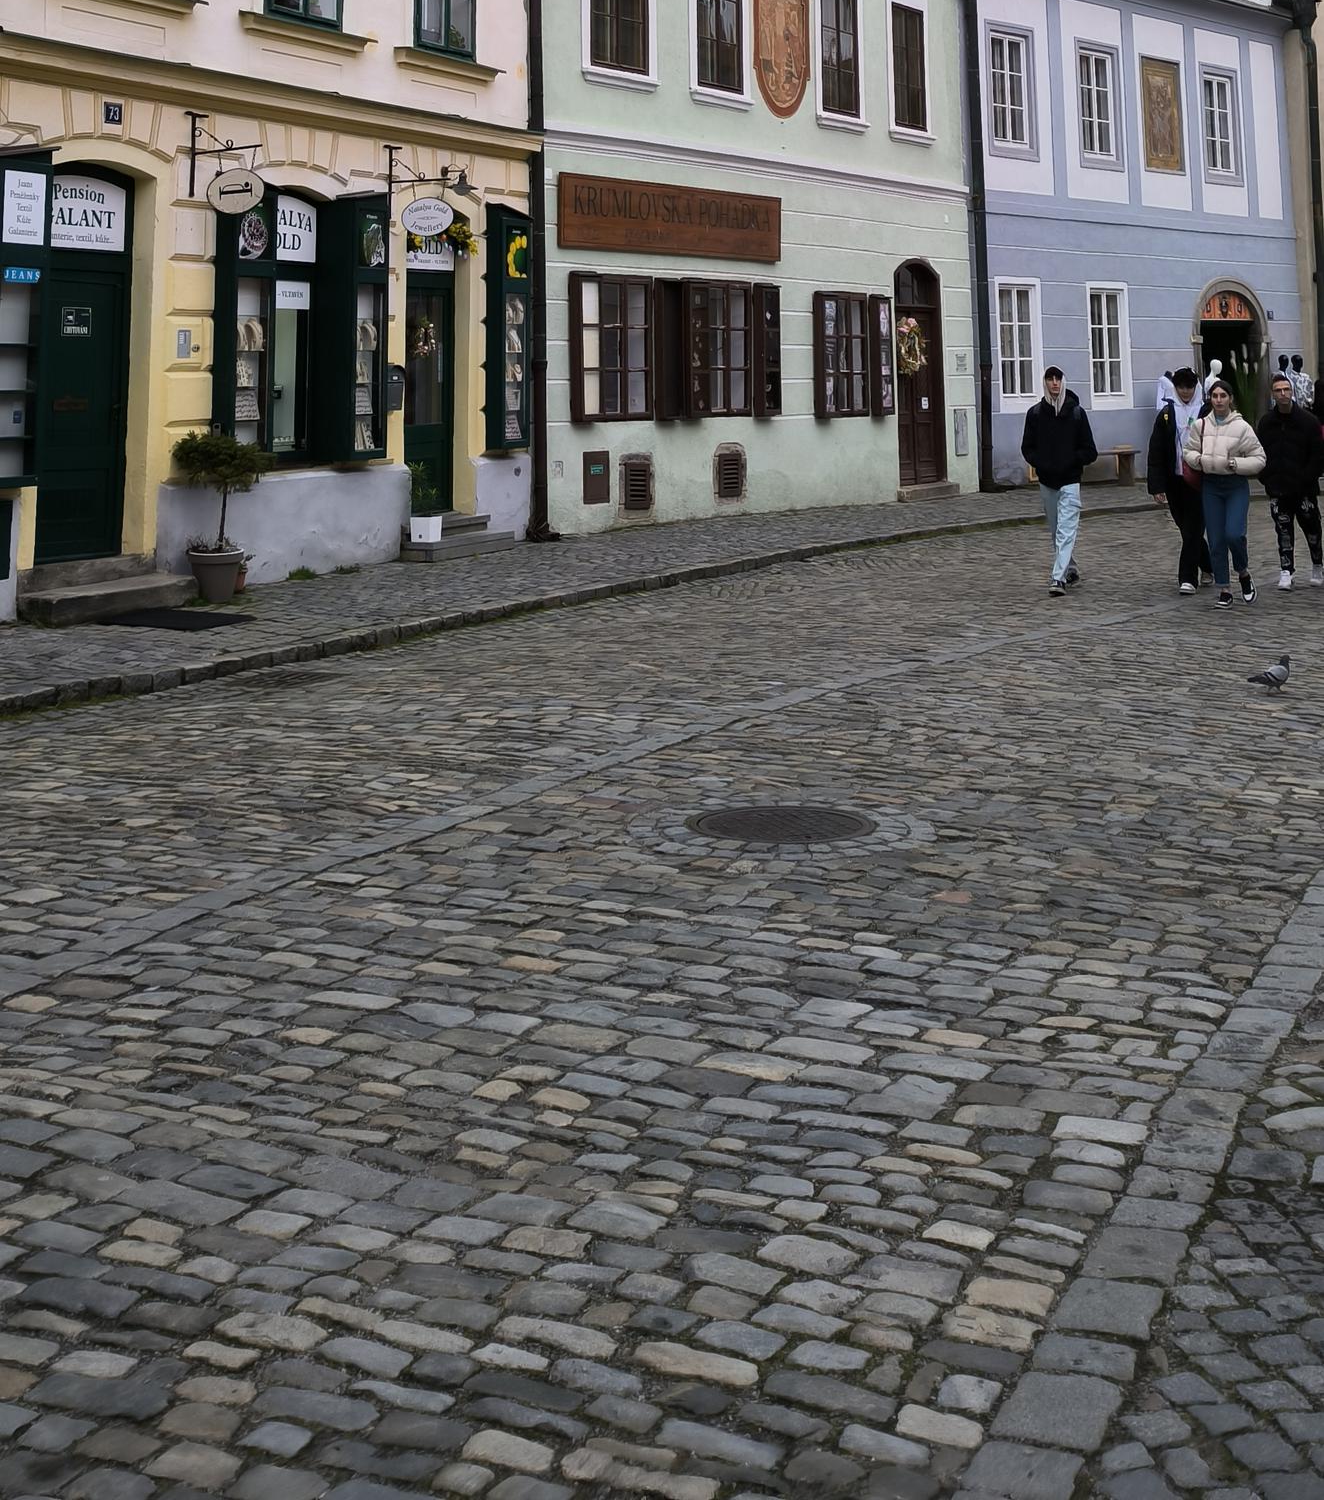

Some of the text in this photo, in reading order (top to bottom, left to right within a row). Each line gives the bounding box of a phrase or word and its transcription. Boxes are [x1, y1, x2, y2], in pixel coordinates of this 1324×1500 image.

[109, 106, 120, 121] 73
[53, 183, 105, 205] Pension
[433, 203, 449, 215] Gold
[573, 185, 693, 224] KRUMLOVSKÁ
[52, 206, 116, 230] ALANT
[277, 209, 313, 233] ALYA
[410, 220, 444, 233] Jewellery
[4, 269, 40, 280] JEANS
